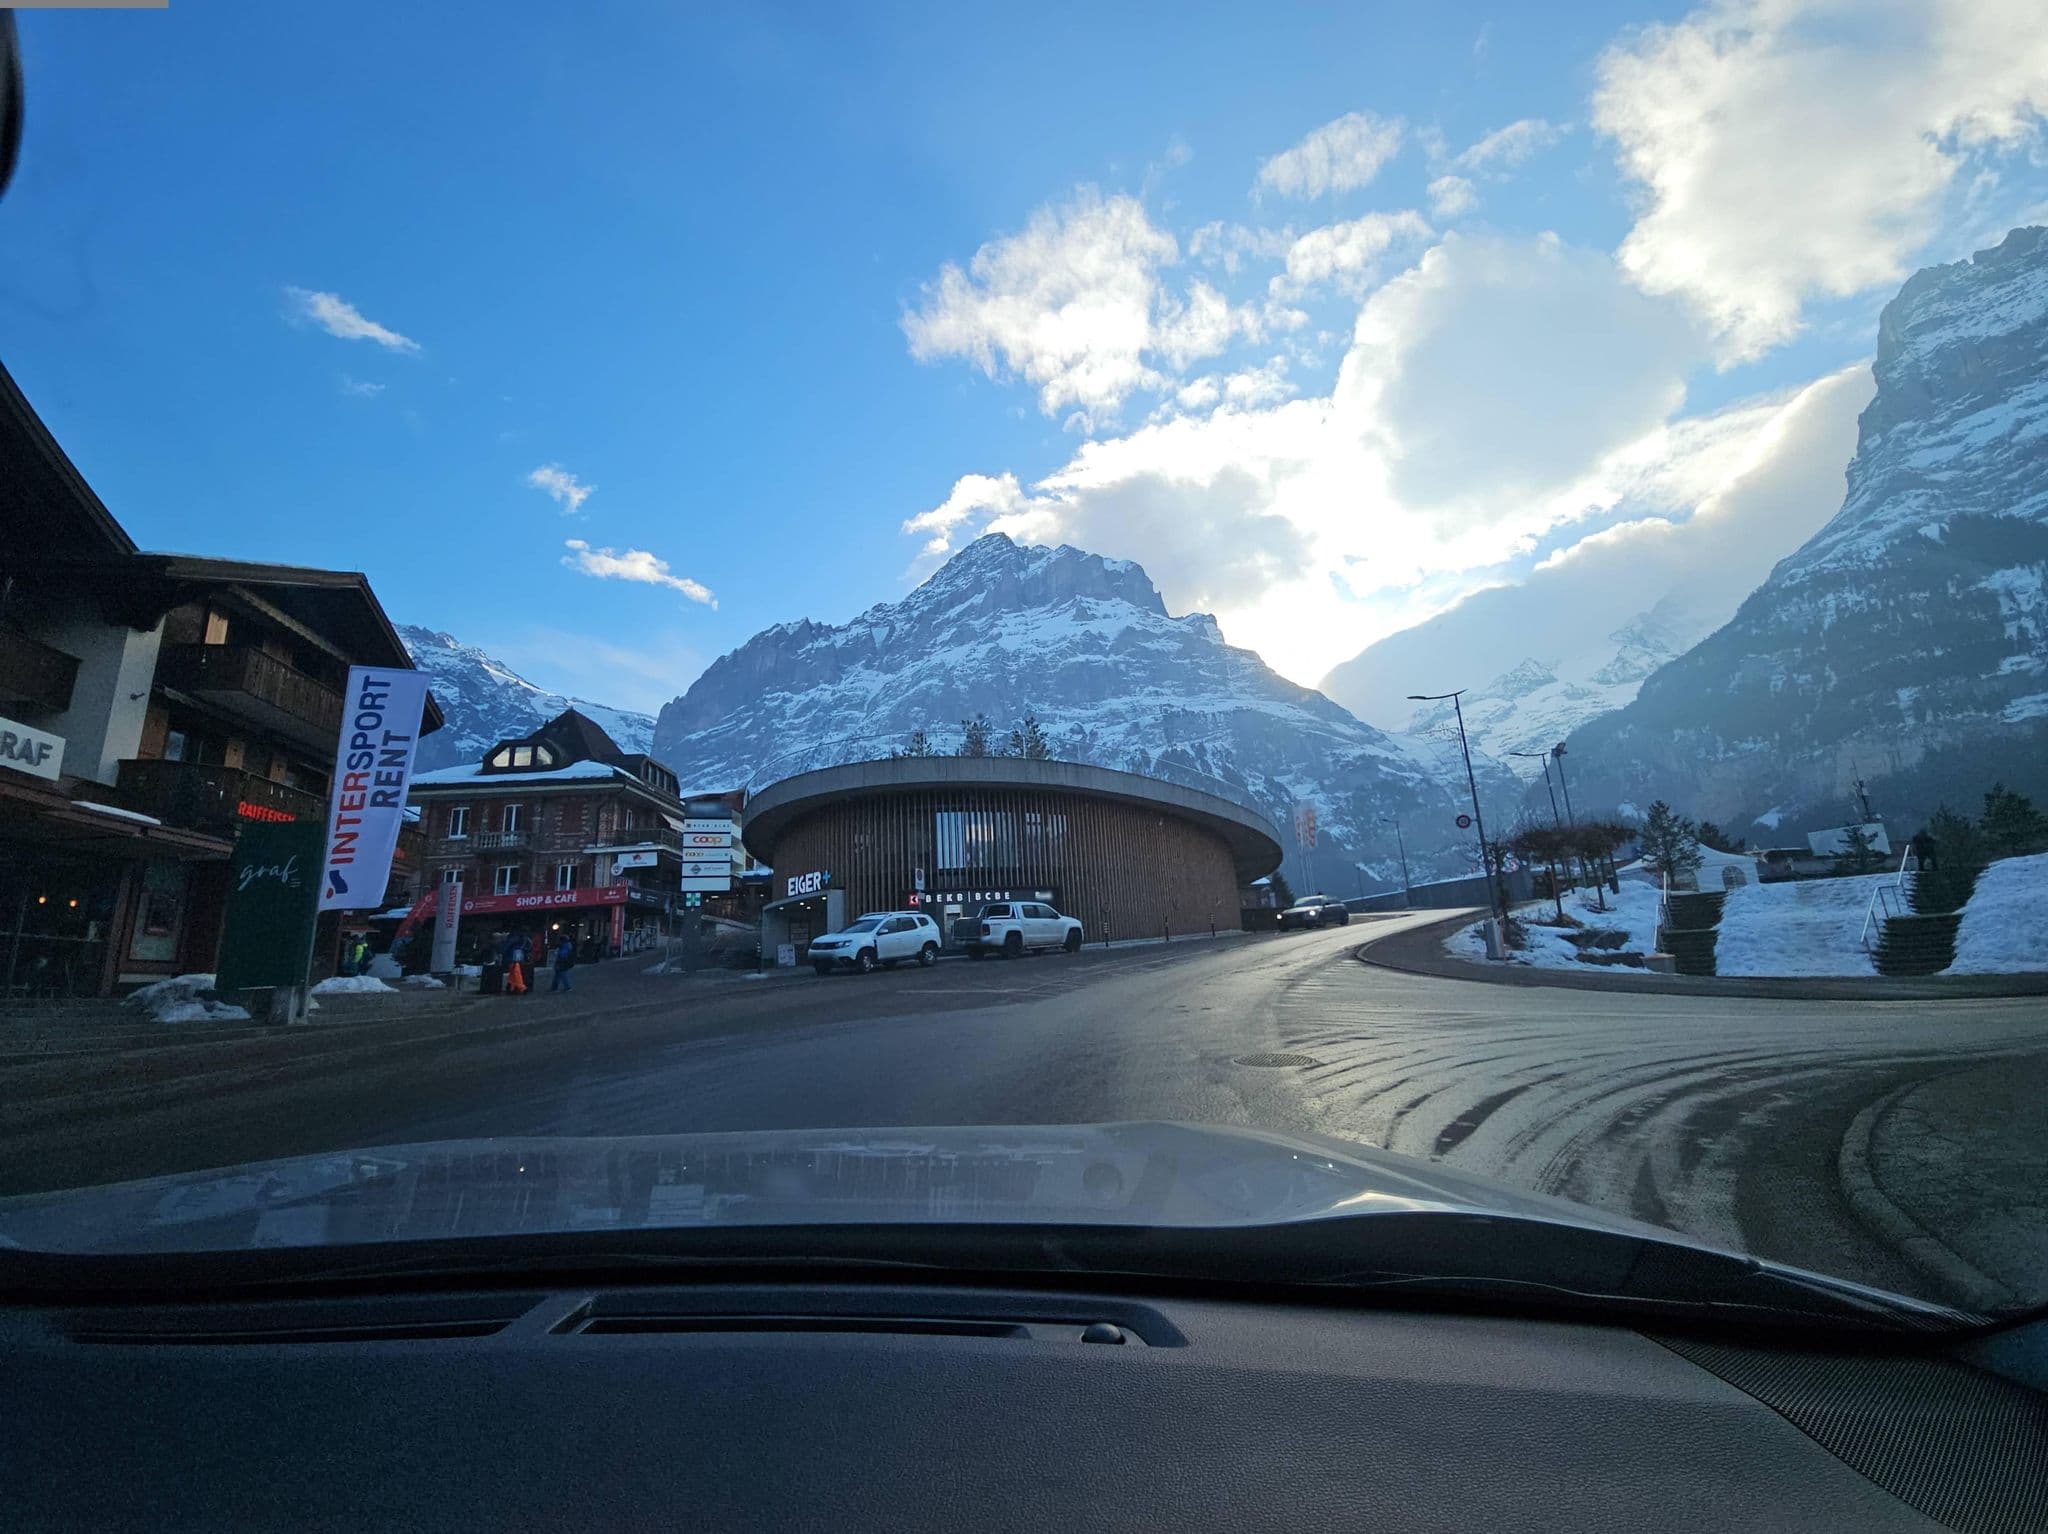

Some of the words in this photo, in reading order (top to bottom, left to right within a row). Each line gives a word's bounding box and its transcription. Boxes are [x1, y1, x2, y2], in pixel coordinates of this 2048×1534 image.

[330, 674, 391, 866] INTERSPORT
[369, 730, 411, 809] RENT
[238, 854, 298, 891] graf
[516, 896, 544, 907] SHOP
[545, 895, 552, 904] &
[554, 891, 577, 903] CAFÉ
[925, 893, 963, 904] BEKB
[975, 891, 1011, 901] BCBE
